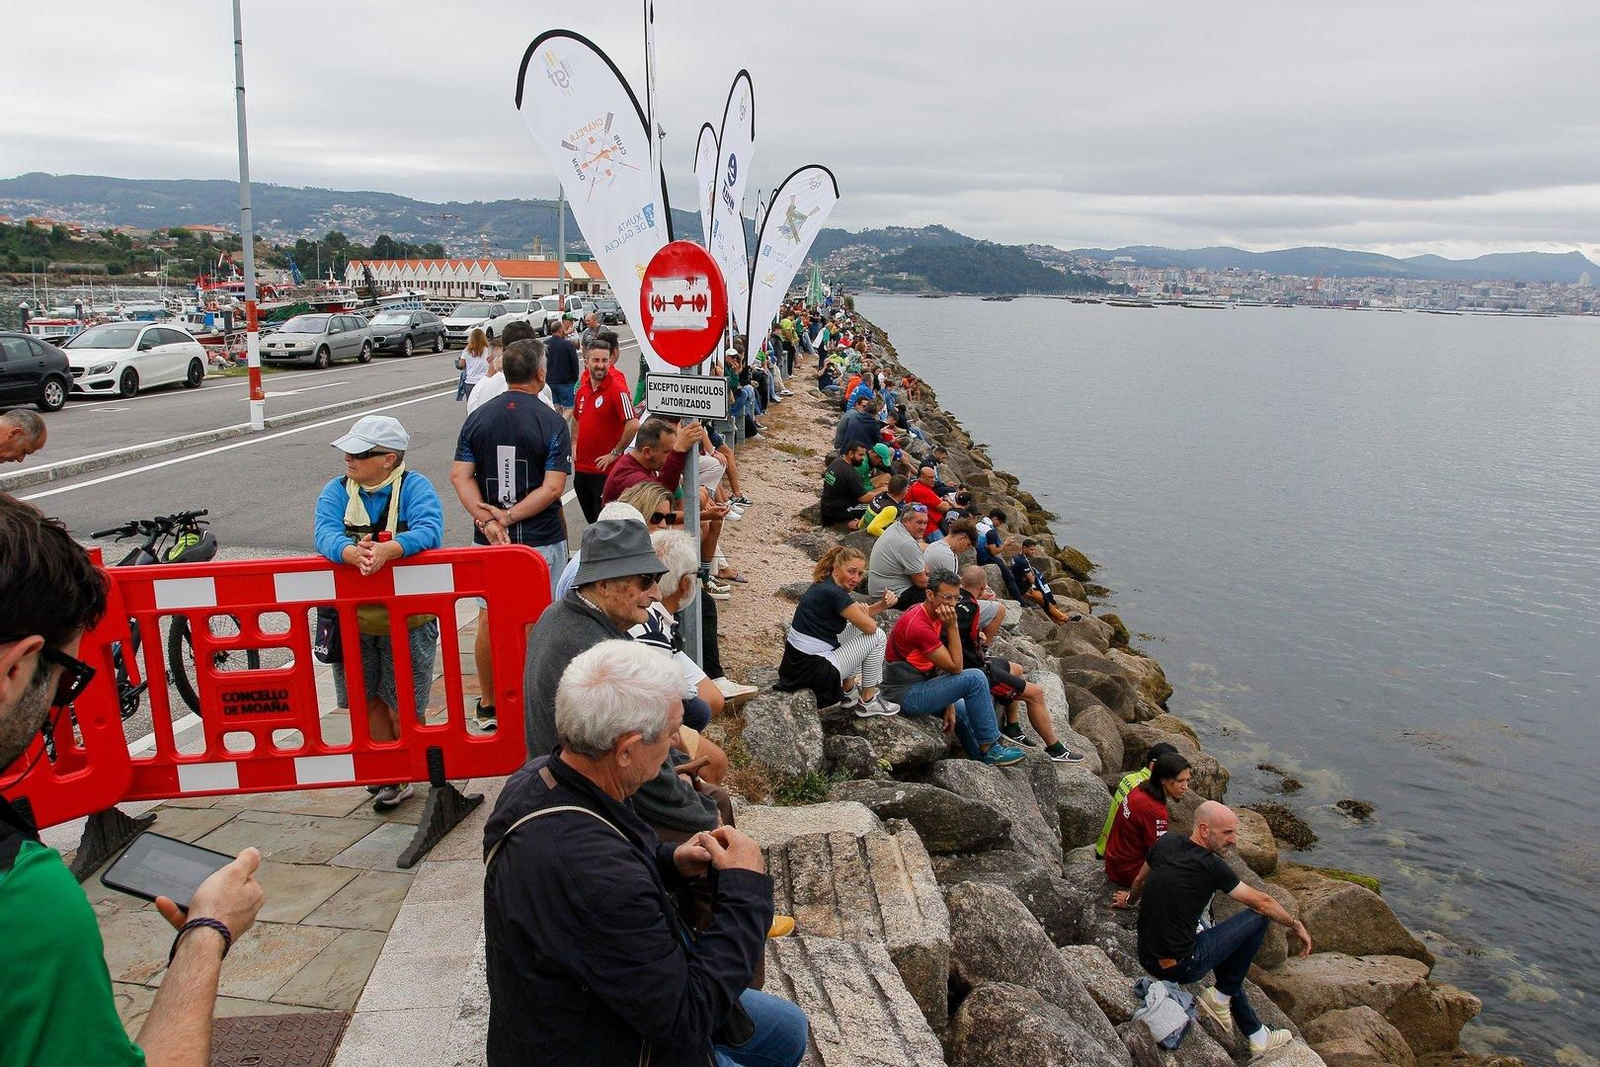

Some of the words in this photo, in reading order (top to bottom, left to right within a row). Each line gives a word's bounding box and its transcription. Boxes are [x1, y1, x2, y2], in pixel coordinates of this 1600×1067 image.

[649, 382, 679, 393] EXCEPTO
[681, 384, 724, 396] VEHICULOS
[661, 397, 711, 410] AUTORIZADOS
[222, 688, 289, 702] CONCELLO
[224, 705, 238, 716] DE
[241, 700, 290, 713] MOAÑA
